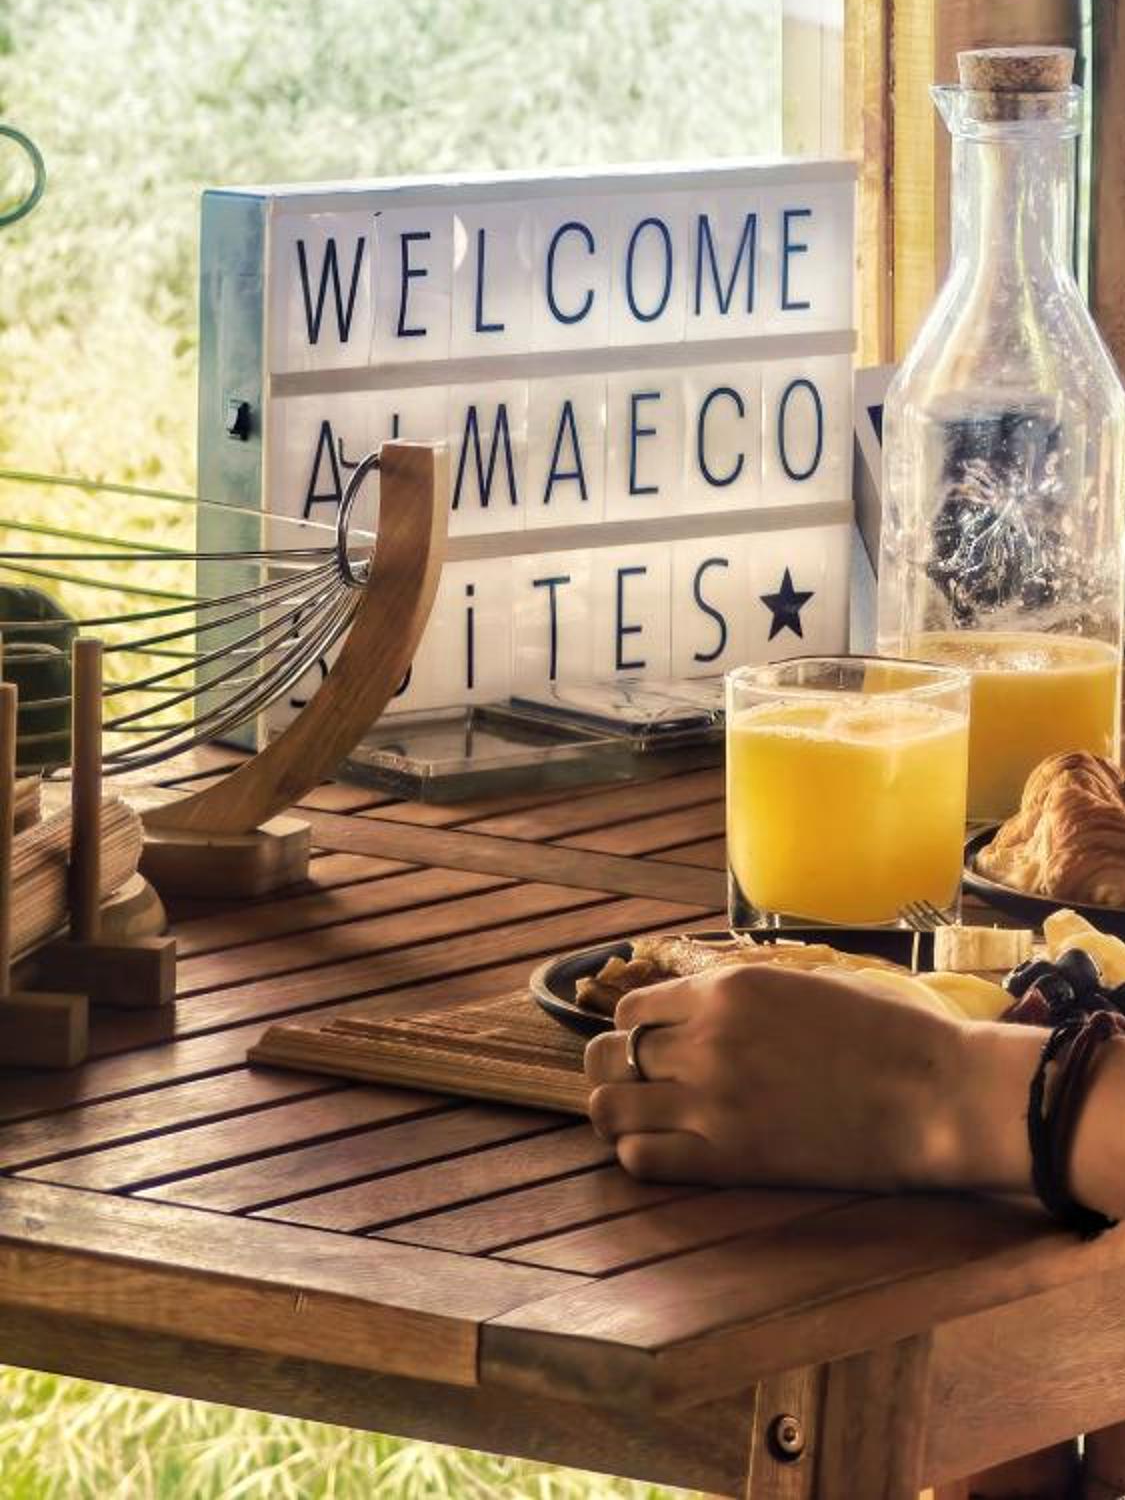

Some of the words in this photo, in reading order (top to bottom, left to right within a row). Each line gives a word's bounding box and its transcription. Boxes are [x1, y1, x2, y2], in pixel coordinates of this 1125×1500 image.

[296, 208, 812, 345] WELCOME
[302, 378, 824, 519] AMAECO
[289, 557, 730, 708] iTES
